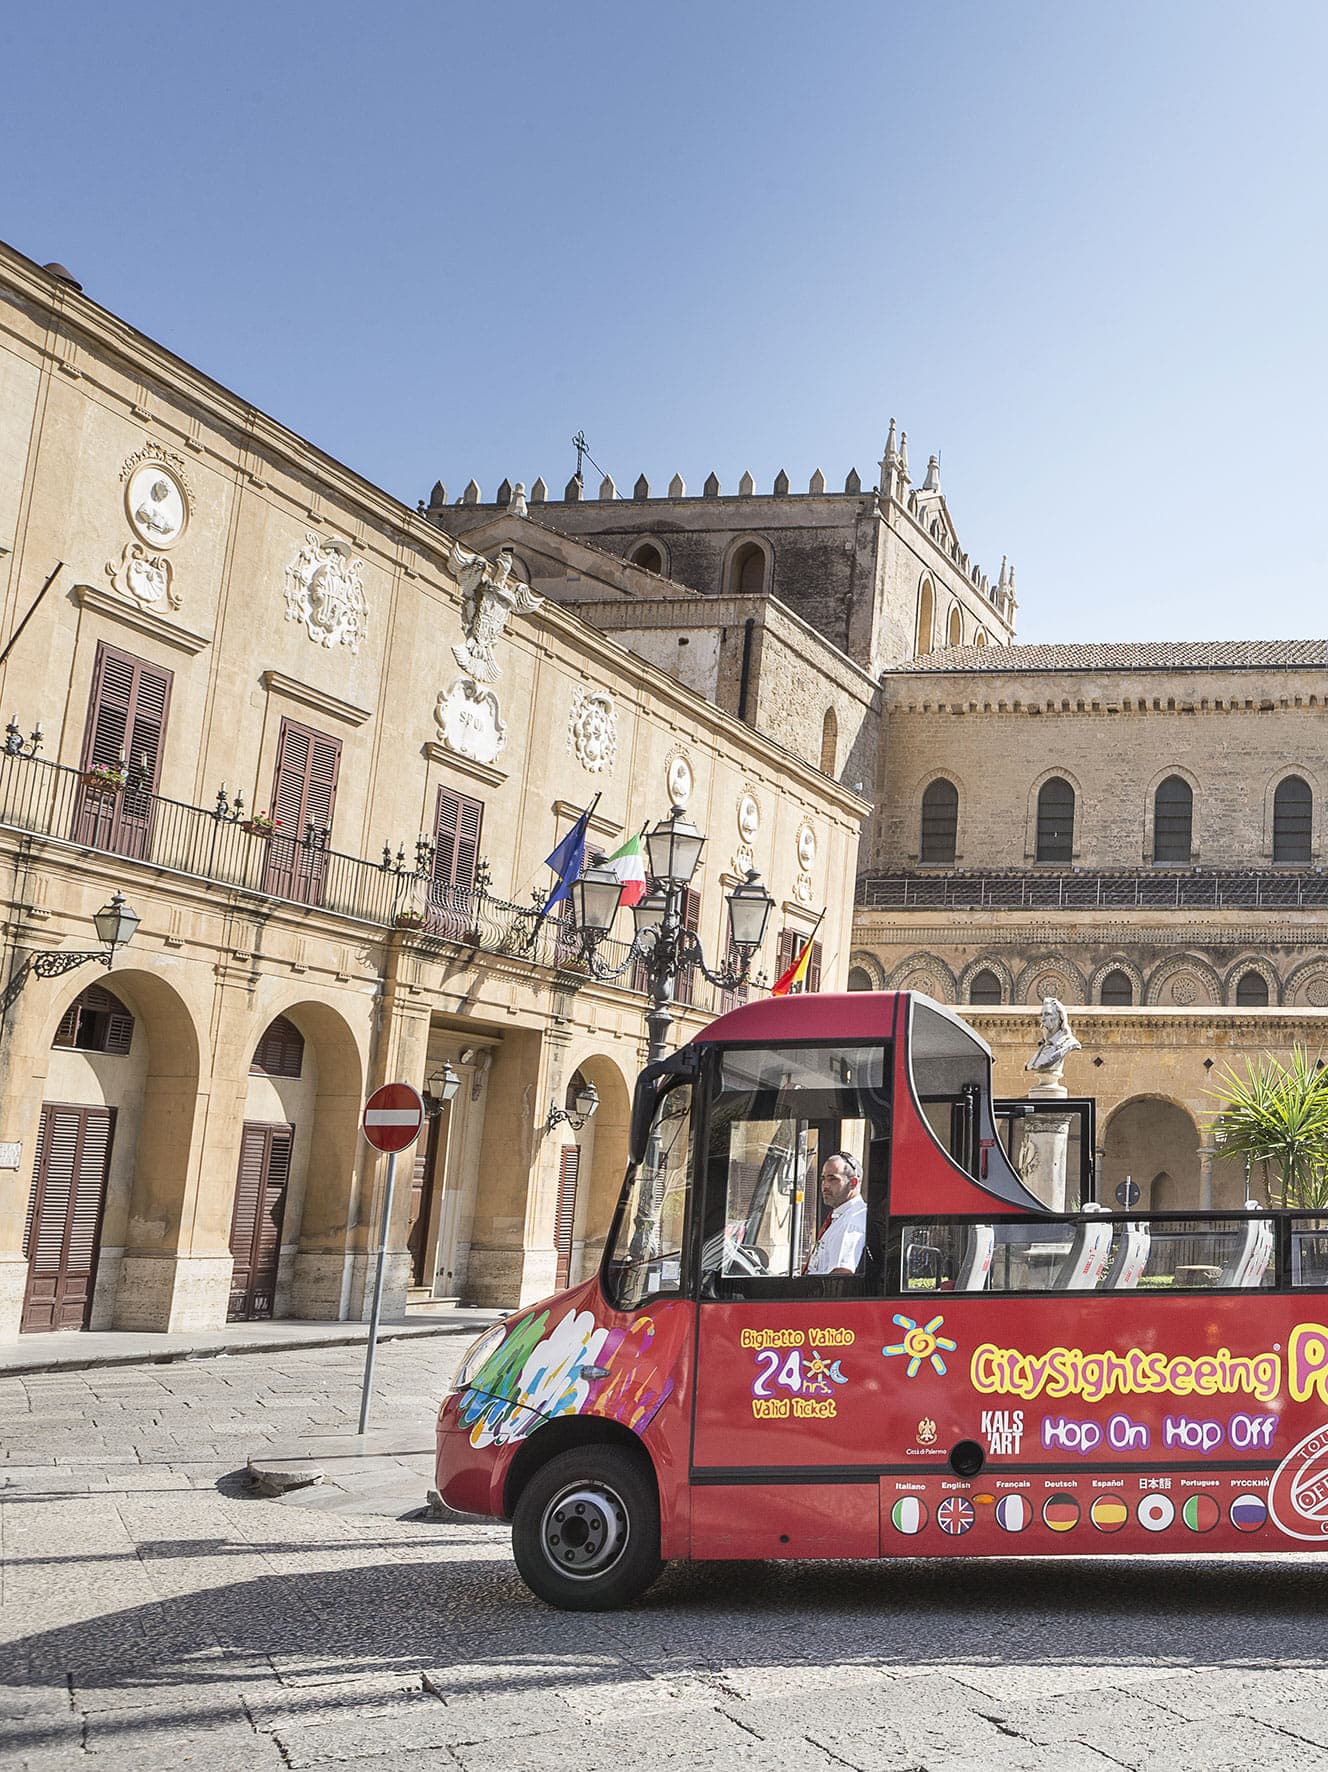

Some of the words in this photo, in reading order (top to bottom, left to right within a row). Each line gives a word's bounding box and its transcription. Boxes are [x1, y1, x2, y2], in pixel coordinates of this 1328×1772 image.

[741, 1328, 805, 1351] Biglietto
[808, 1327, 856, 1347] Valido
[753, 1349, 802, 1396] 24
[802, 1379, 833, 1395] hrs.
[752, 1398, 790, 1419] Valid
[791, 1397, 838, 1419] Ticket
[980, 1410, 1025, 1433] KALS
[1042, 1416, 1102, 1453] Hop
[1107, 1413, 1149, 1450] On
[1164, 1416, 1224, 1453] Hop
[1229, 1413, 1278, 1450] Off
[926, 1448, 948, 1456] Palermo
[895, 1482, 926, 1492] Italiano
[941, 1481, 971, 1490] English
[996, 1480, 1031, 1489] Français
[1044, 1480, 1078, 1488] Deutsch
[1092, 1479, 1124, 1488] Español
[1138, 1477, 1172, 1489] 日本語
